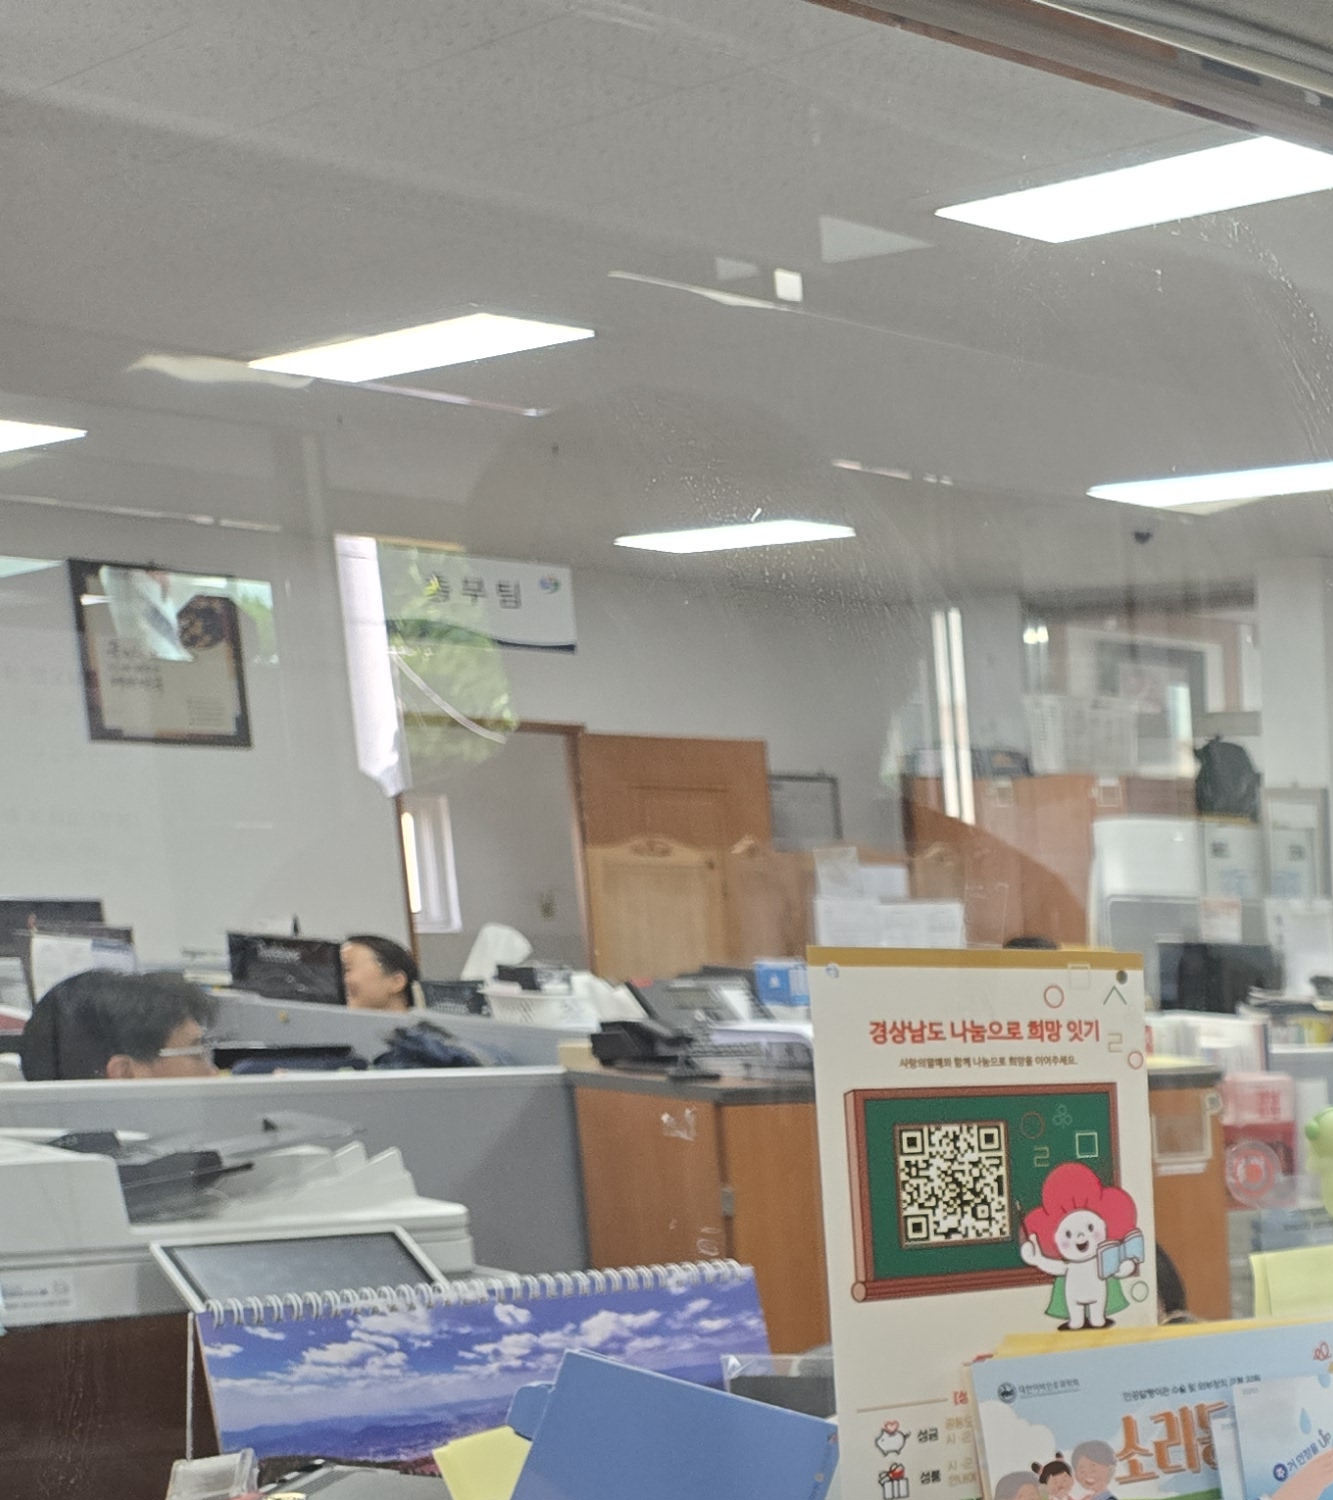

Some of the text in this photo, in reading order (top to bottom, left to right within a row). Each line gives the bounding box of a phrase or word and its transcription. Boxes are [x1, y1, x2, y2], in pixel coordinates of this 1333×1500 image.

[868, 1020, 1100, 1044] 경상남도 나눔으로 희망 잇기
